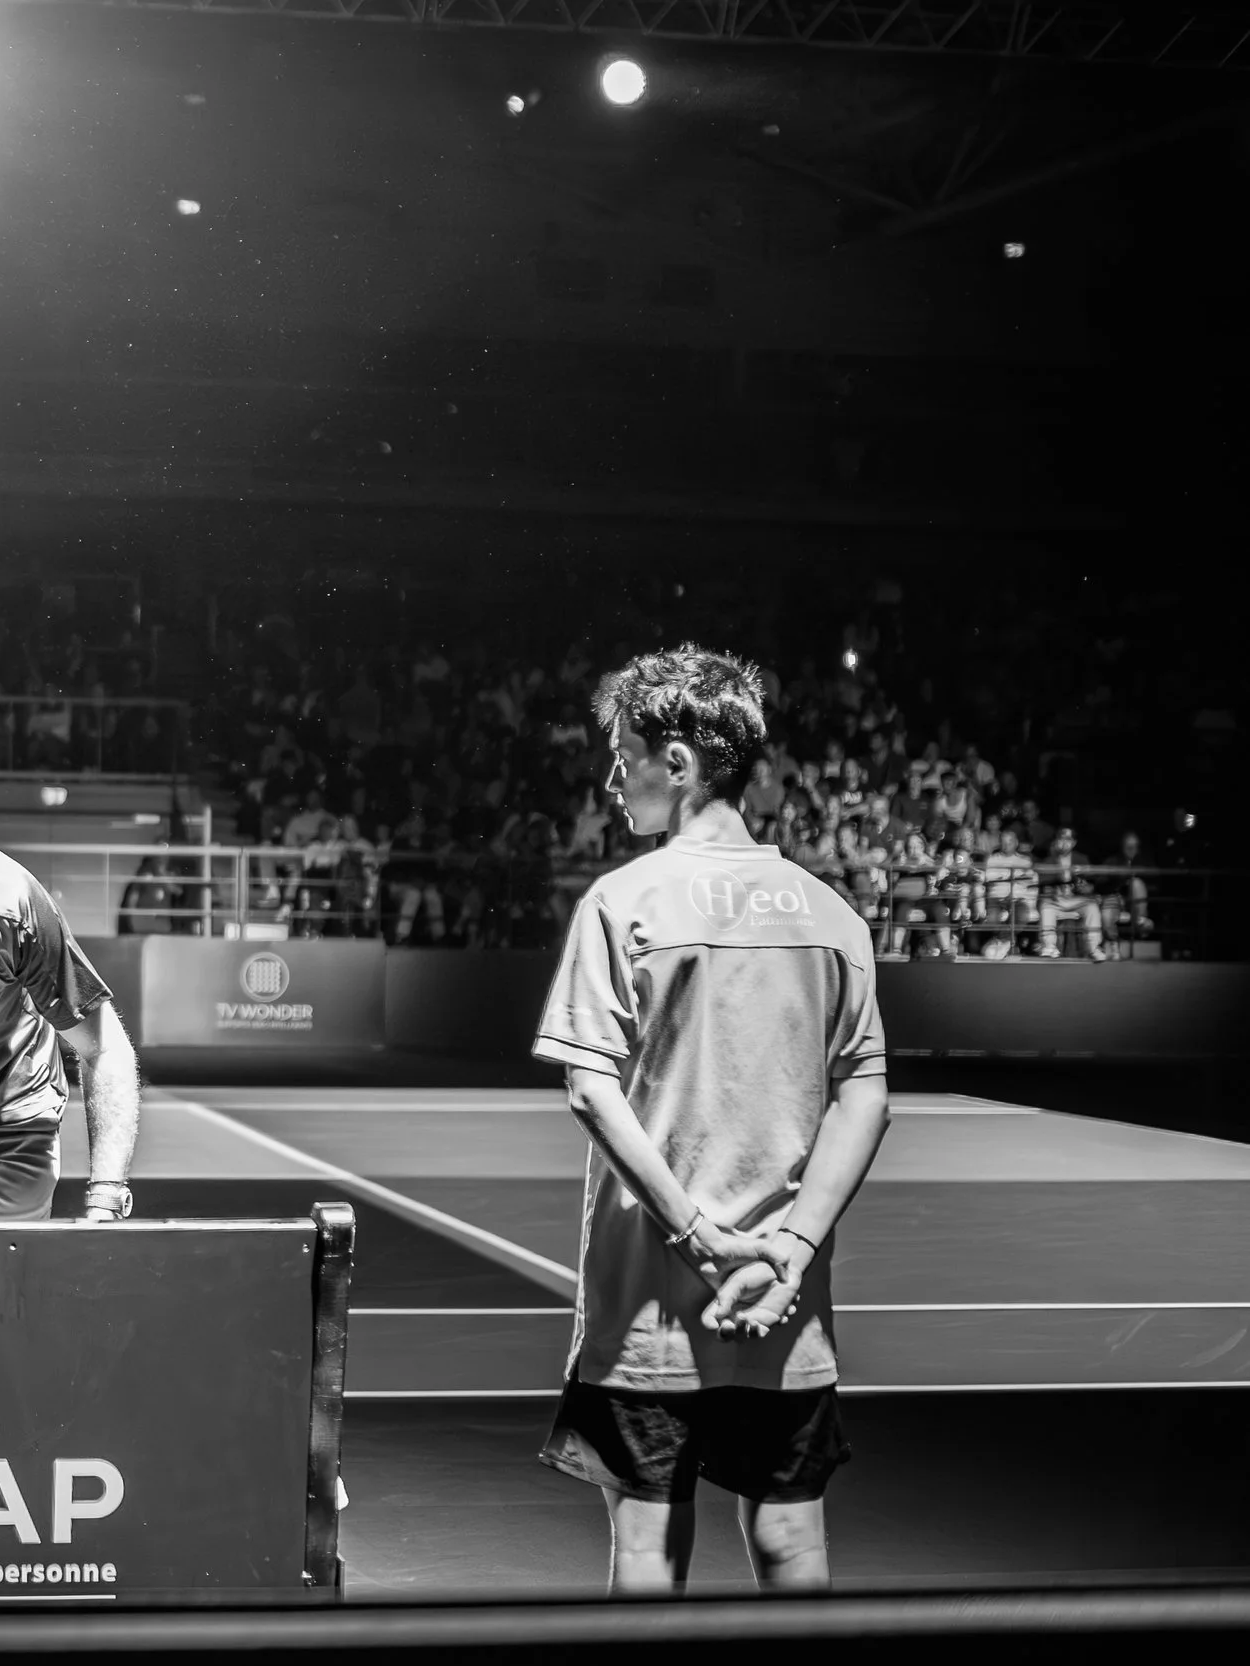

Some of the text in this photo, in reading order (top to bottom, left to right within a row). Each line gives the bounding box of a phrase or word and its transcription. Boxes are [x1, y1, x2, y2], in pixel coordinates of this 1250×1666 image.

[696, 877, 812, 918] Heol
[216, 1002, 314, 1020] TV WONDER
